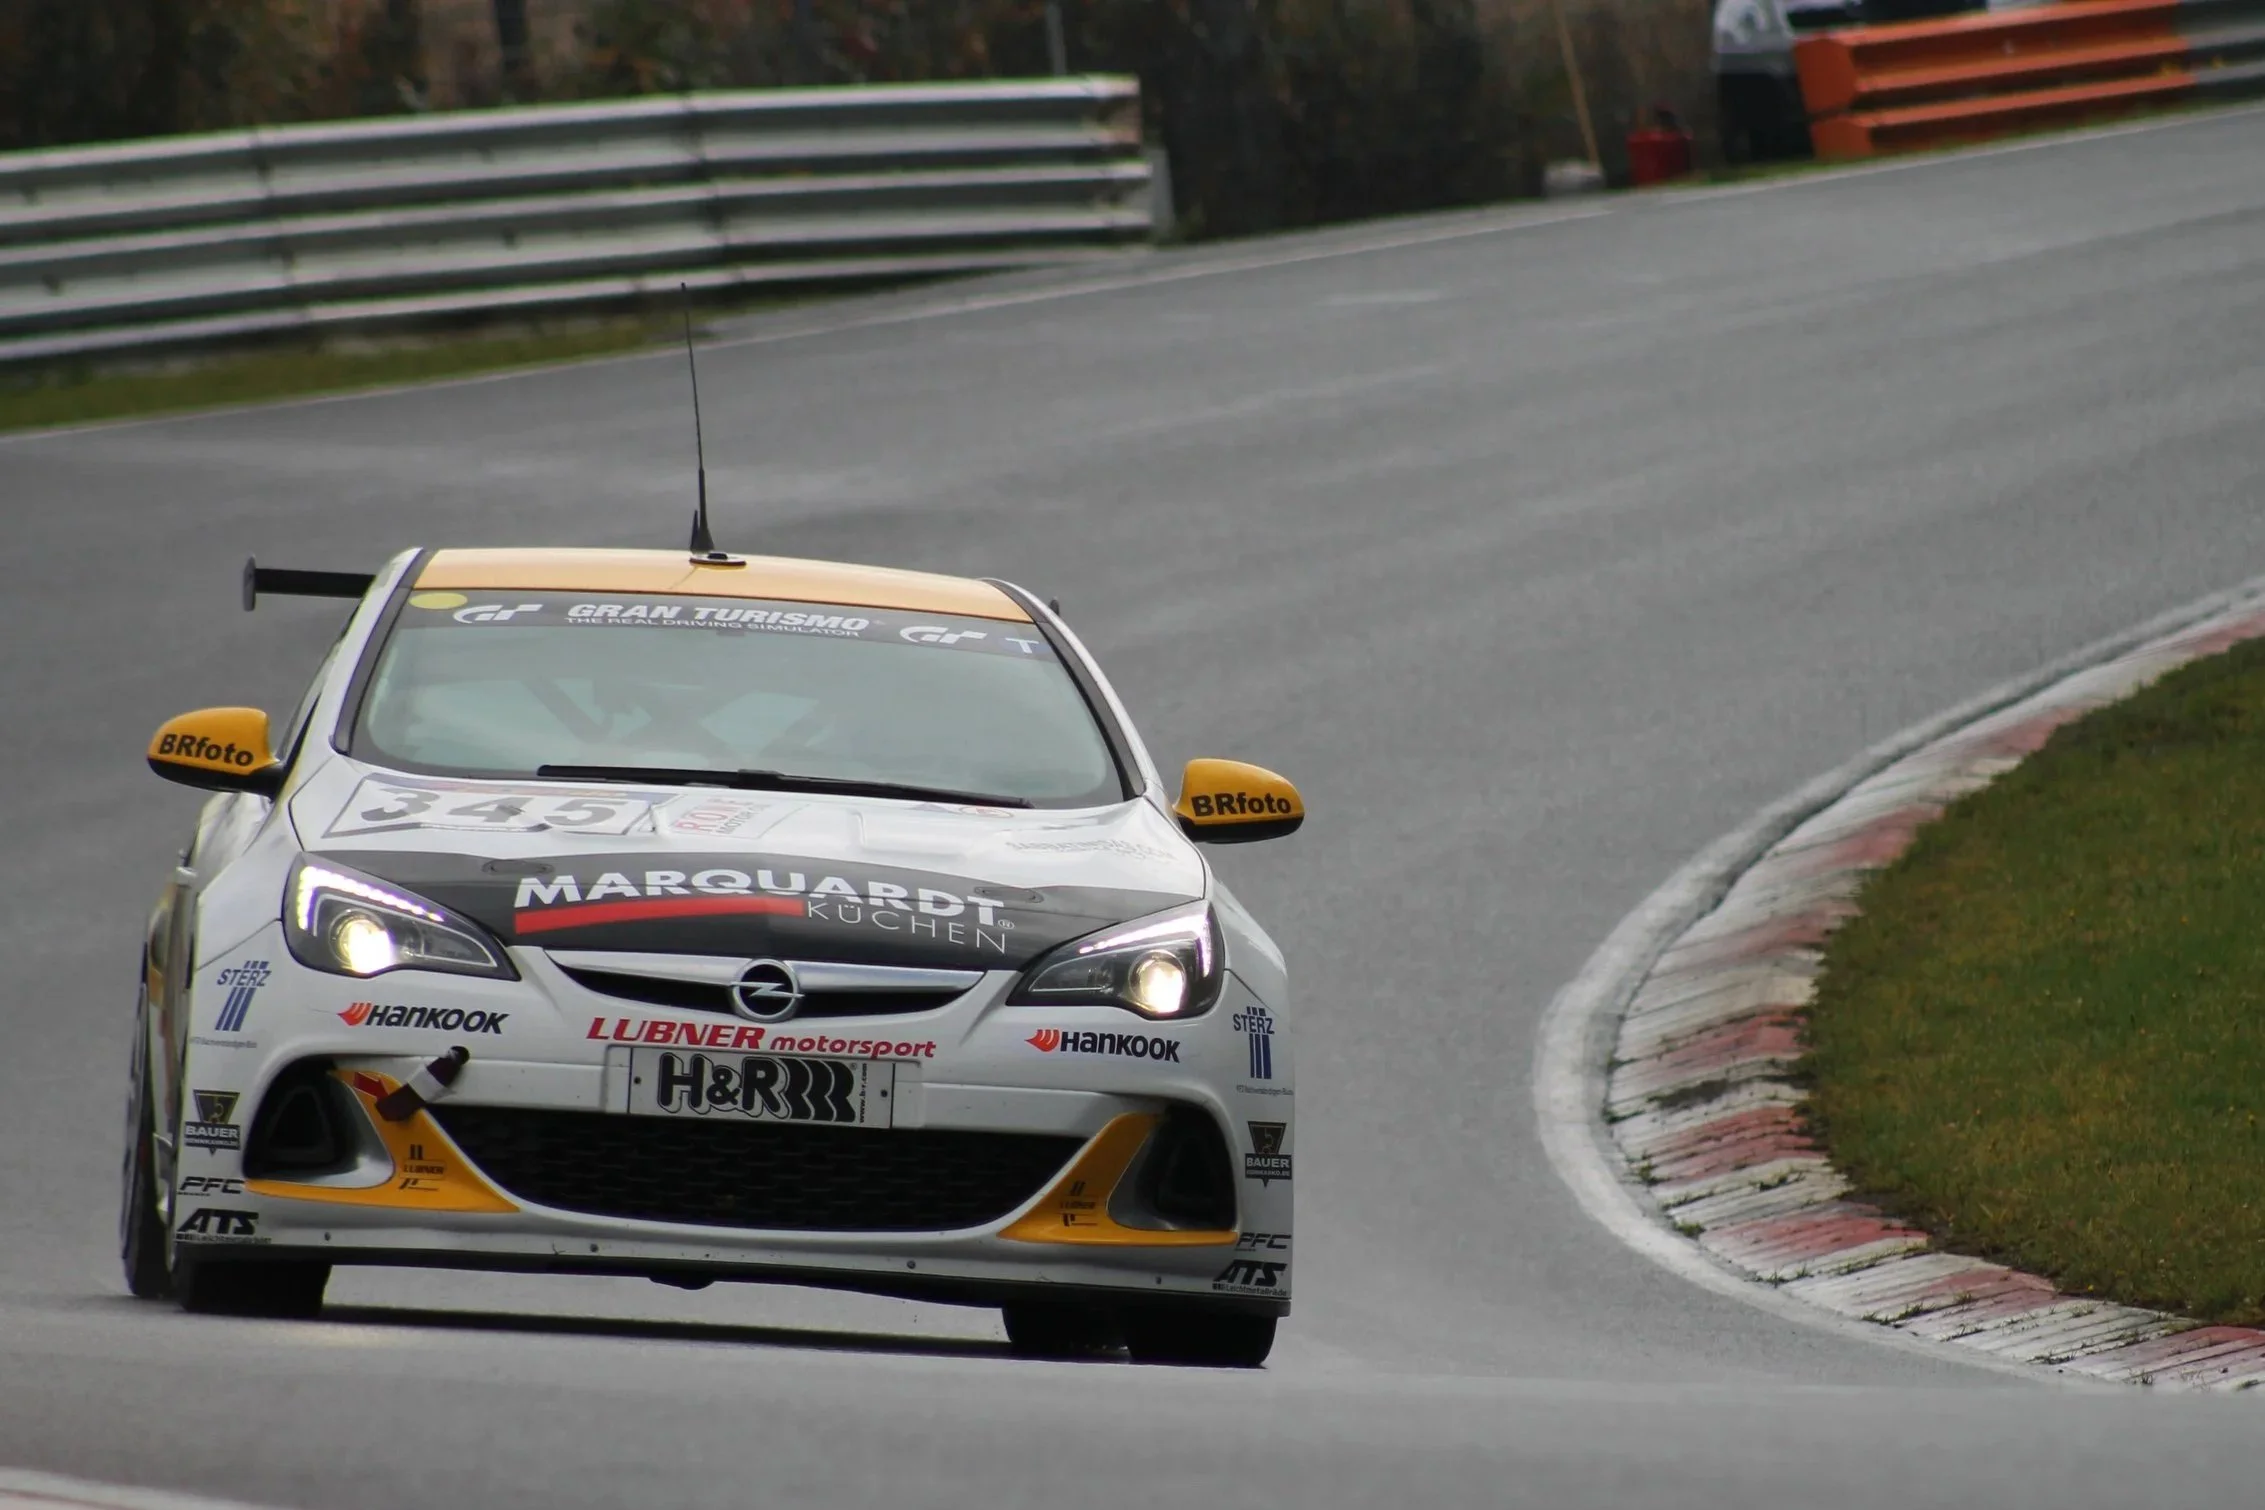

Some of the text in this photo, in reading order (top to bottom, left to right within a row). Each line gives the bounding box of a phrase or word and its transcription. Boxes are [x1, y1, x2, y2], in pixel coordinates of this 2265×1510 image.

[564, 617, 861, 638] THE REAL DRIVING SIMULATOR
[566, 603, 870, 632] GRAN TURISMO
[158, 733, 255, 767] BRfoto
[360, 787, 630, 827] 345
[1190, 791, 1292, 817] BRfoto
[513, 868, 1005, 928] MARQUARDT
[806, 900, 1007, 955] KÜCHEN
[215, 968, 272, 988] STERZ
[365, 1003, 510, 1036] HANKOOK
[1231, 1013, 1276, 1036] STERZ
[586, 1016, 937, 1061] LUBNER motorsport
[1059, 1030, 1181, 1064] HANKOOK
[185, 1124, 239, 1139] BAUER
[1245, 1157, 1291, 1170] BAUER
[179, 1175, 246, 1195] PFC
[176, 1207, 260, 1236] ATS
[1235, 1231, 1292, 1250] PFC
[1212, 1258, 1288, 1288] ATS
